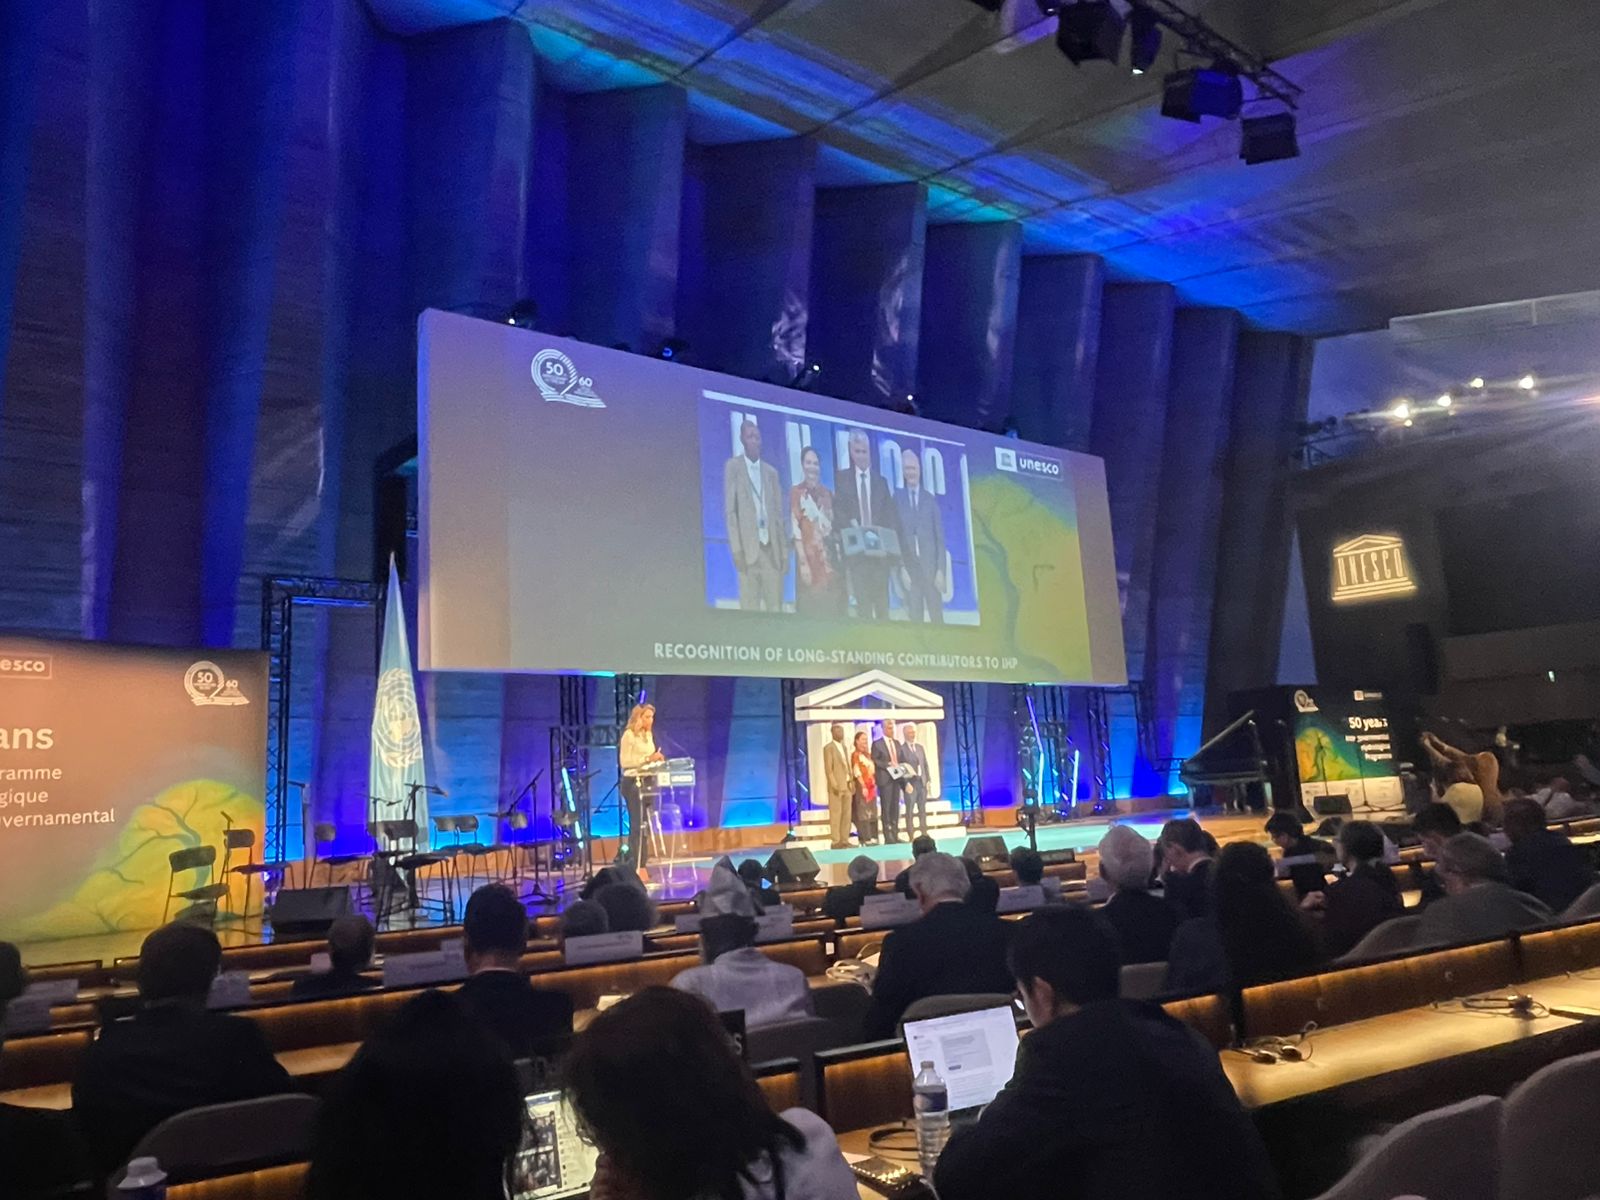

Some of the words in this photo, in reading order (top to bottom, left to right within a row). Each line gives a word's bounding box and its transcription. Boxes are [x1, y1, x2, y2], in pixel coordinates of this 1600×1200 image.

[546, 361, 564, 375] 50
[578, 376, 592, 387] 60
[1019, 457, 1059, 475] unesco
[654, 642, 760, 661] RECOGNITION
[764, 646, 783, 661] OF
[787, 648, 895, 665] LONG-STANDING
[897, 652, 983, 669] CONTRIBUTORS
[984, 656, 999, 669] TO
[197, 671, 213, 683] 50
[1348, 716, 1362, 729] 50
